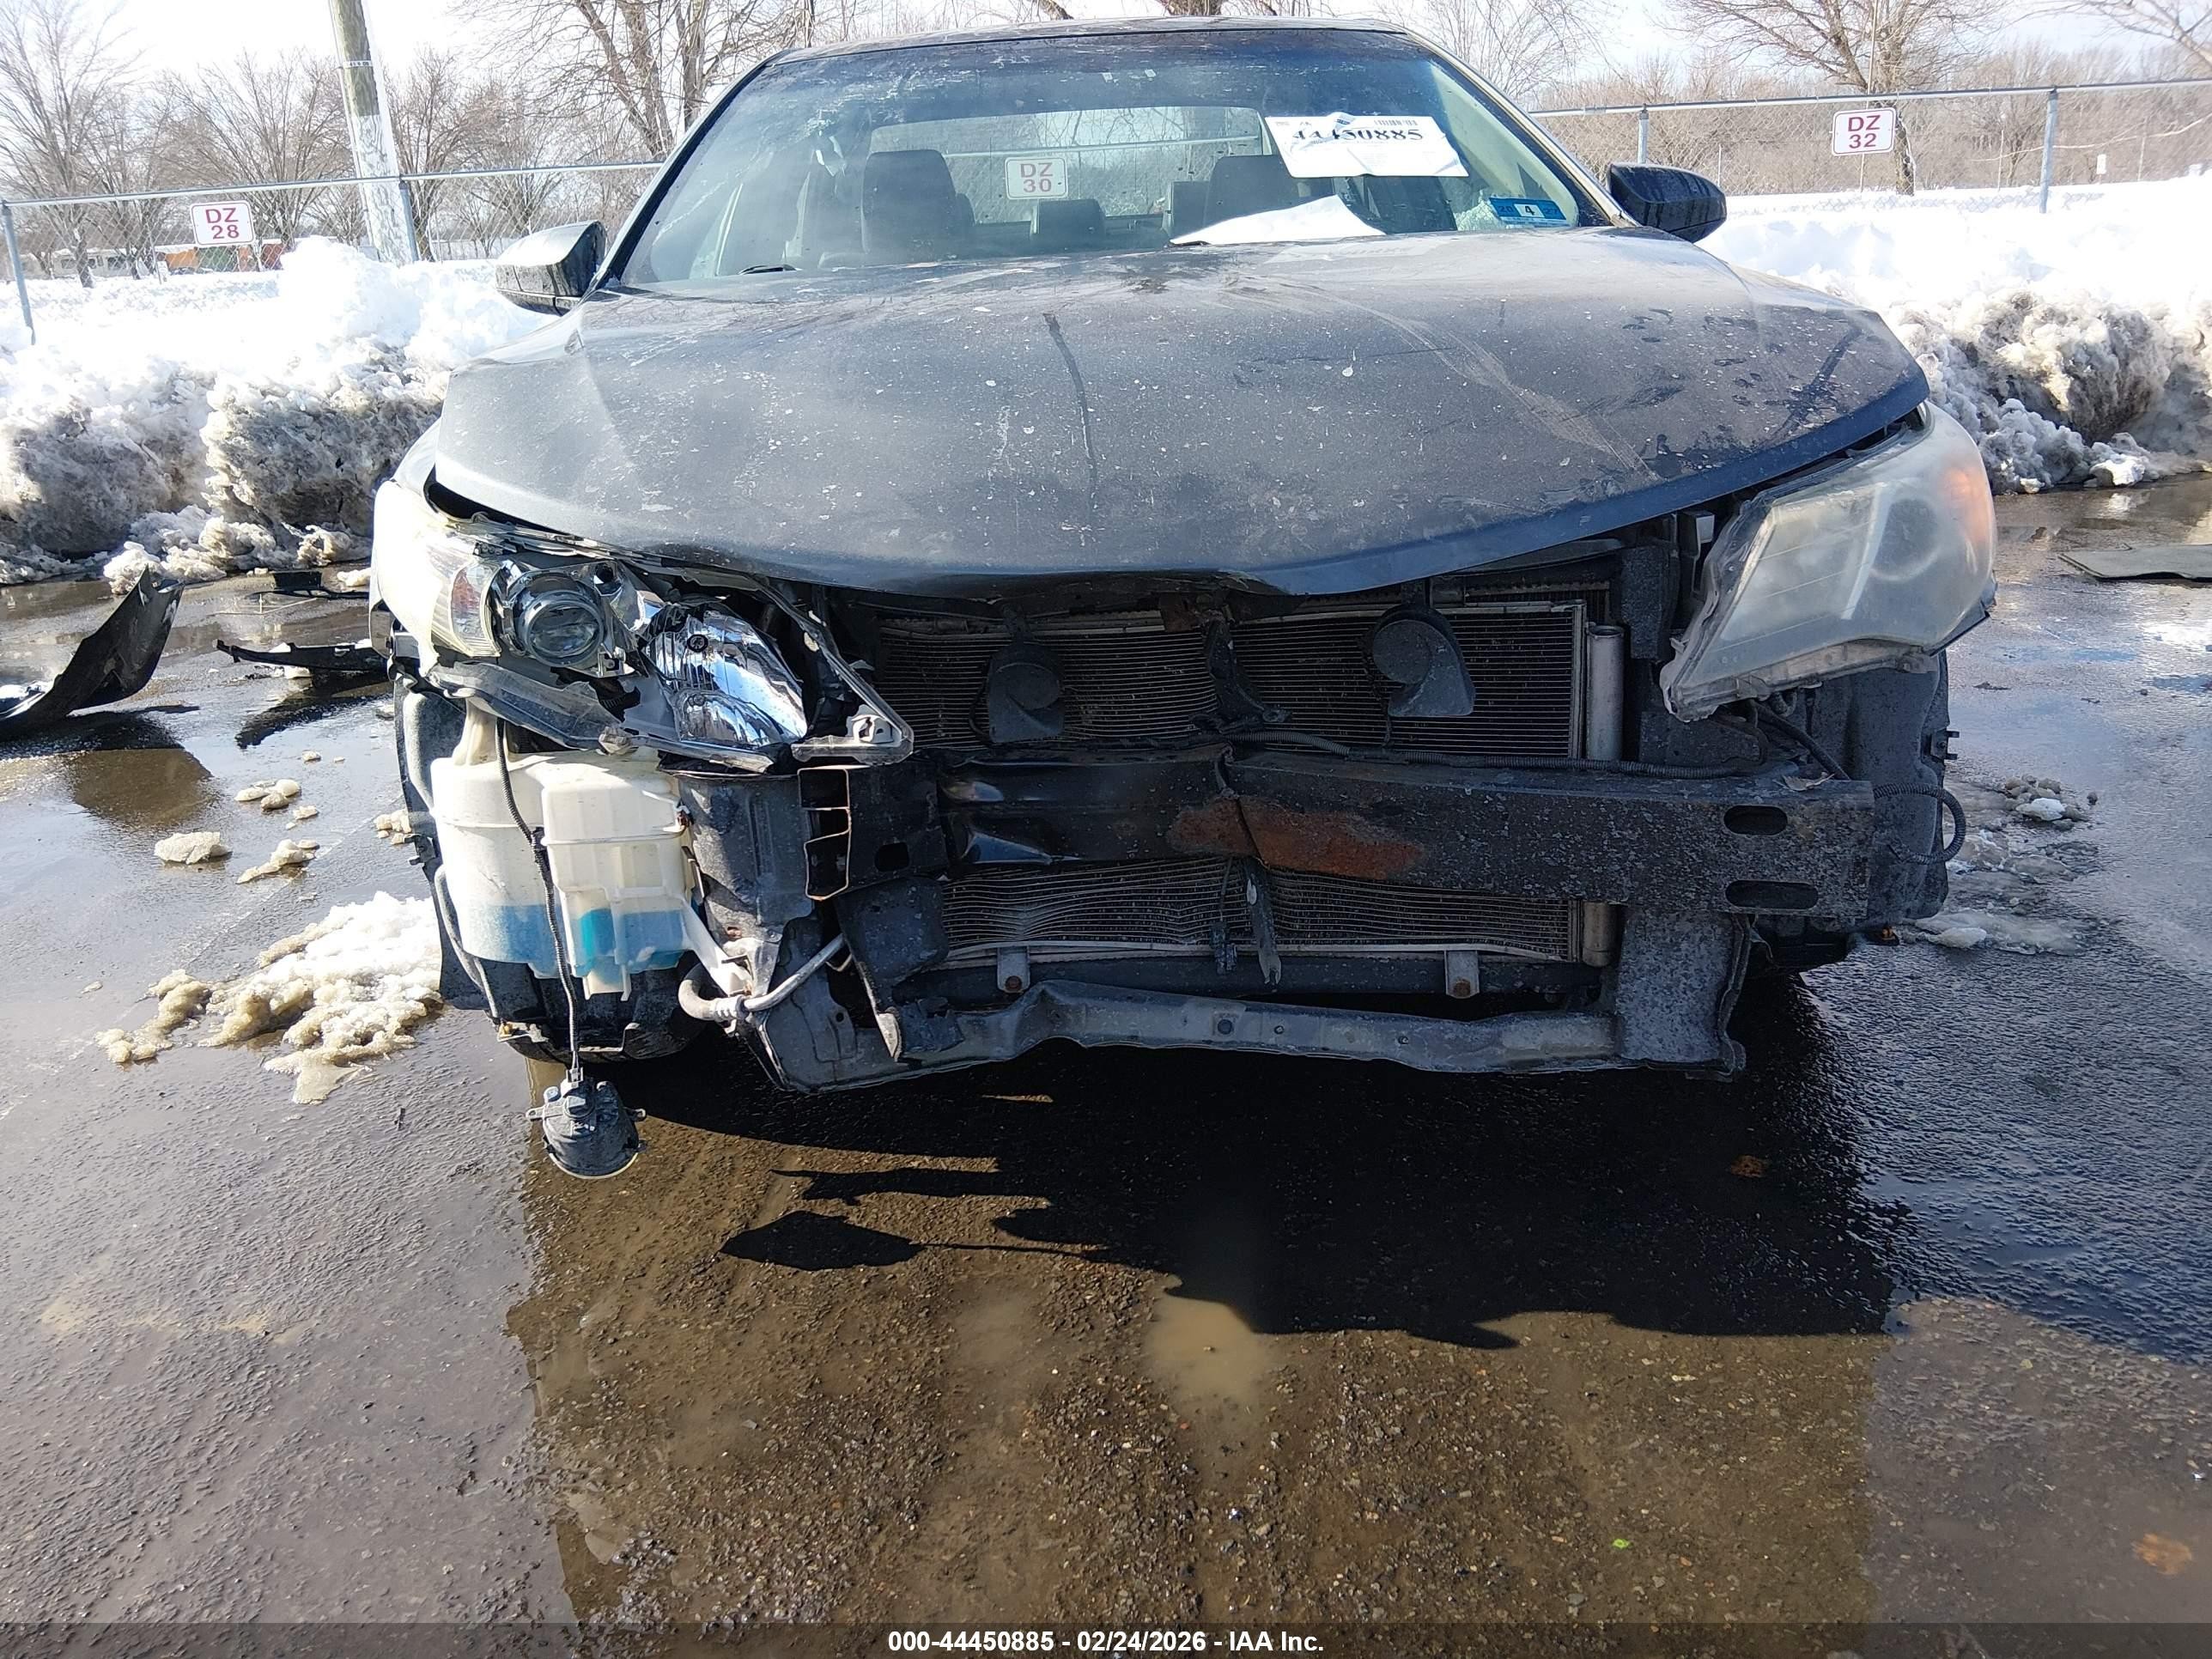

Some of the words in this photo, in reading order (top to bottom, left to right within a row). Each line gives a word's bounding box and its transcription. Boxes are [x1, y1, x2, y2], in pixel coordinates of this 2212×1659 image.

[1848, 115, 1881, 131] DZ
[1849, 133, 1876, 149] 32
[1020, 162, 1053, 178] DZ
[1023, 179, 1052, 192] 30
[205, 208, 239, 223] DZ
[1525, 205, 1535, 216] 4
[211, 225, 240, 240] 28
